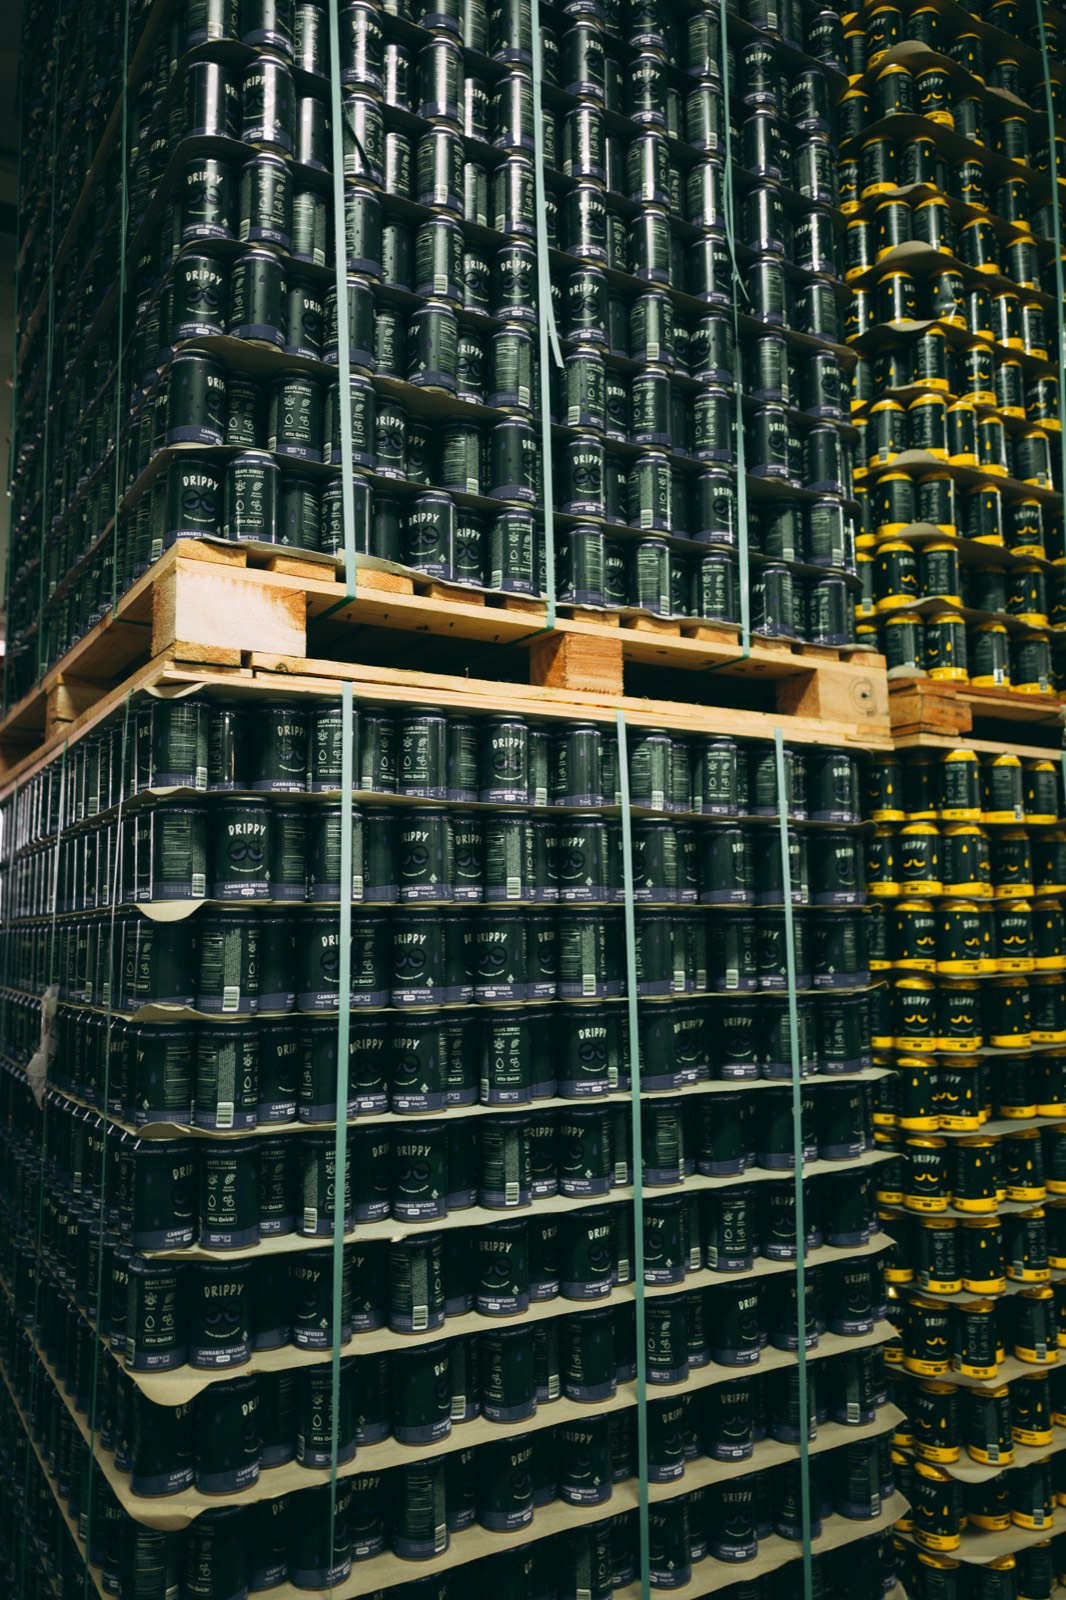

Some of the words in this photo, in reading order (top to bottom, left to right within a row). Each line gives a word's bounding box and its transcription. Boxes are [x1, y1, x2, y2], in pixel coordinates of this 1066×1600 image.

[351, 20, 384, 40] DRIPPY
[744, 51, 772, 65] DRIPPY
[631, 68, 661, 82] DRIPPY
[187, 170, 224, 186] DRIPPY
[500, 259, 533, 272] DRIPPY
[185, 269, 223, 286] DRIPPY
[569, 285, 600, 296] DRIPPY
[573, 455, 603, 467] DRIPPY
[183, 474, 219, 491] DRIPPY
[408, 512, 440, 527] DRIPPY
[492, 738, 525, 750] DRIPPY
[227, 823, 267, 837] DRIPPY
[578, 1028, 608, 1040] DRIPPY
[397, 1145, 431, 1157] DRIPPY
[203, 1283, 245, 1299] DRIPPY
[198, 1348, 224, 1357] CANNABIS
